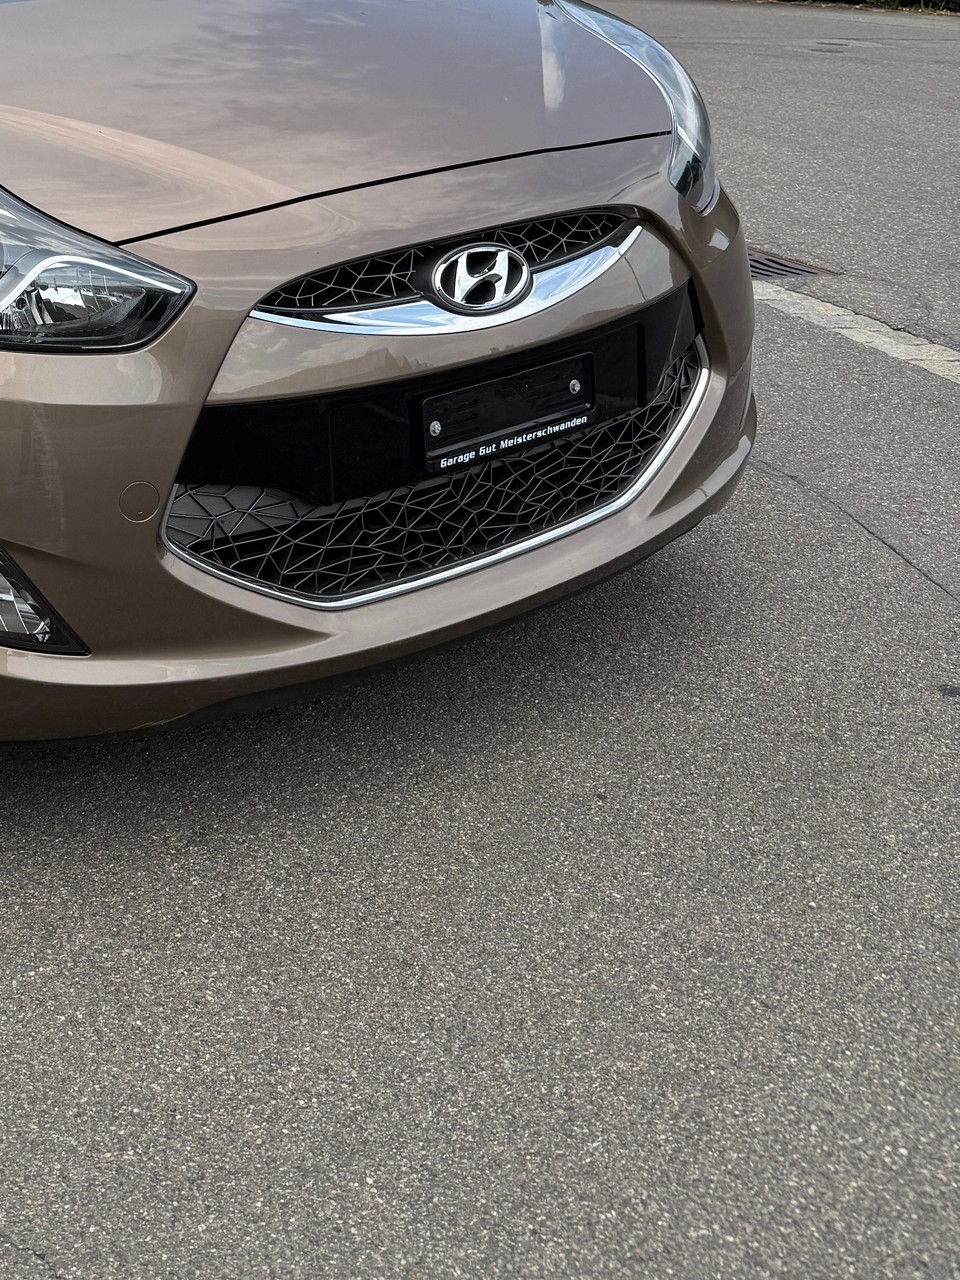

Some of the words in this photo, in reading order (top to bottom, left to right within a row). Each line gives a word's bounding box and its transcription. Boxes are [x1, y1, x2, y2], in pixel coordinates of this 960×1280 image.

[440, 451, 476, 468] Garage
[478, 443, 497, 456] Gut
[499, 416, 588, 450] Meisterschwanden
